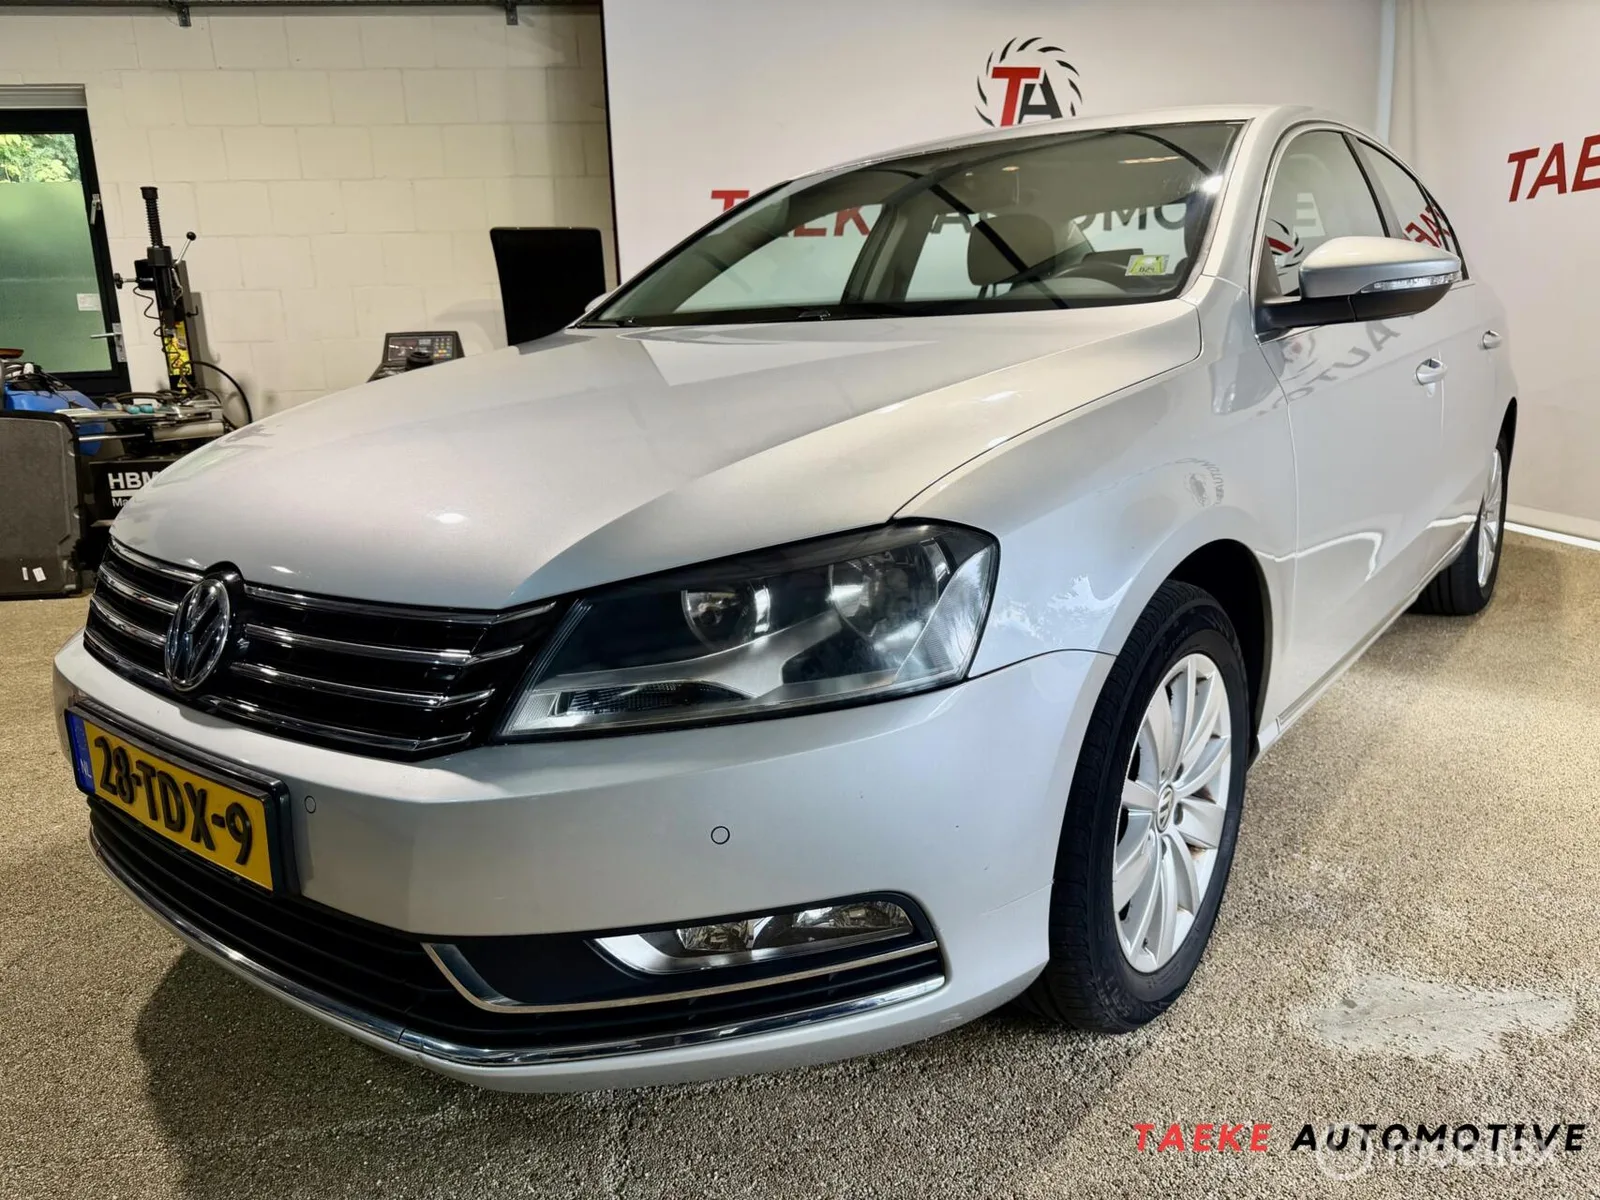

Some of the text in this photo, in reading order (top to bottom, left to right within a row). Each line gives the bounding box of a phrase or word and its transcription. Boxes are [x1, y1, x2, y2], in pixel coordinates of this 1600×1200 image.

[992, 67, 1062, 127] TA
[1507, 133, 1600, 203] TAE
[94, 735, 254, 866] 28-TDX-9
